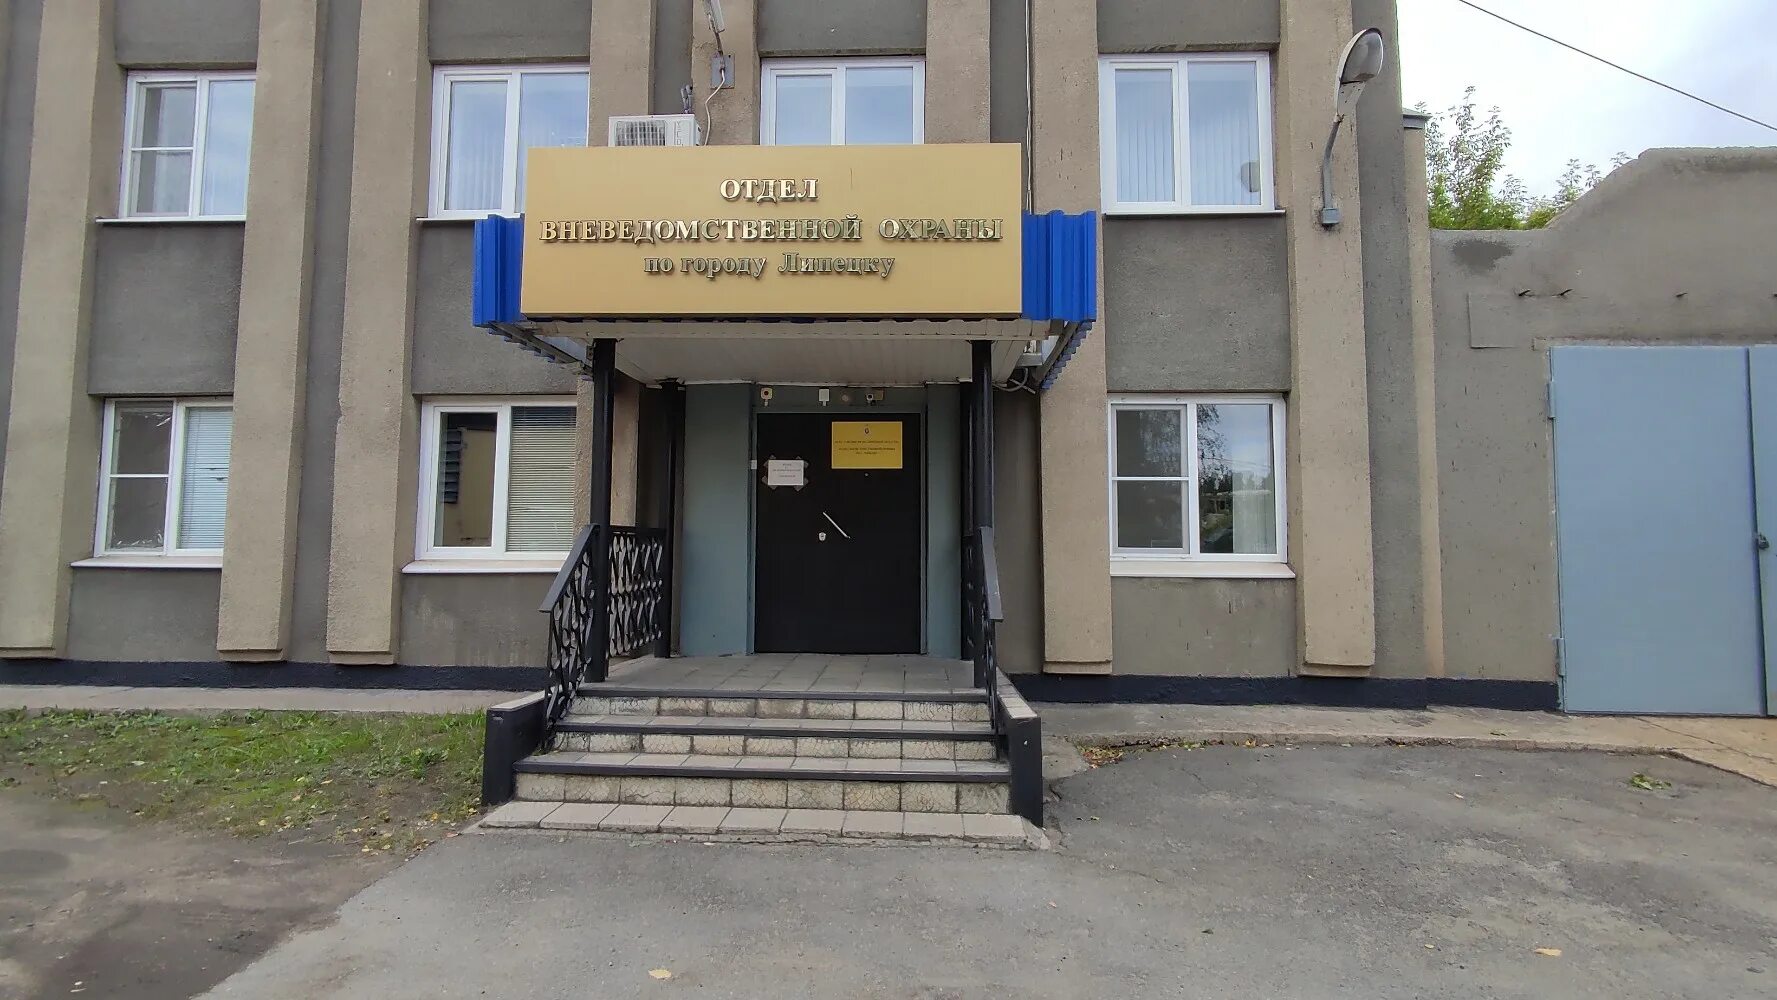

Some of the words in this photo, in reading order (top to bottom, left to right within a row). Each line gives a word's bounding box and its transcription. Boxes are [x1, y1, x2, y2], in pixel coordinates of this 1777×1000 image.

[719, 178, 819, 204] ОТДЕЛ
[539, 215, 863, 245] ВНЕВЕДОМСТВЕННОЙ
[878, 217, 1004, 242] ОХРАНЫ
[644, 256, 673, 274] по
[681, 255, 767, 279] городу
[777, 252, 896, 279] Липецку
